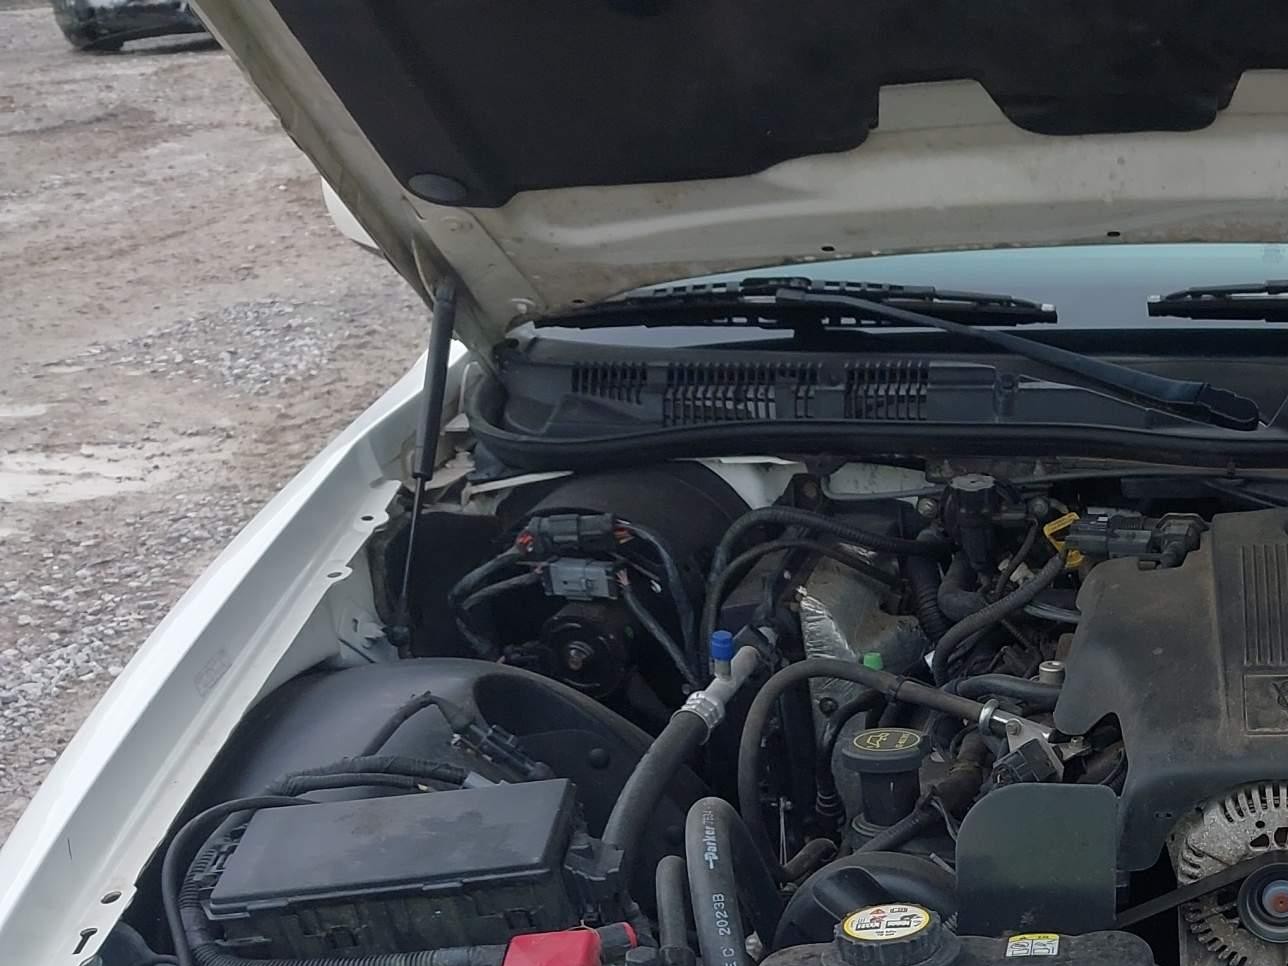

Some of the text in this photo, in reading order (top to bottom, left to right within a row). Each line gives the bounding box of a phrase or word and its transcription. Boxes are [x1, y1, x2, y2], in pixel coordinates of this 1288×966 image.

[703, 825, 719, 869] Parker
[712, 893, 731, 936] 2023B
[722, 946, 735, 957] C
